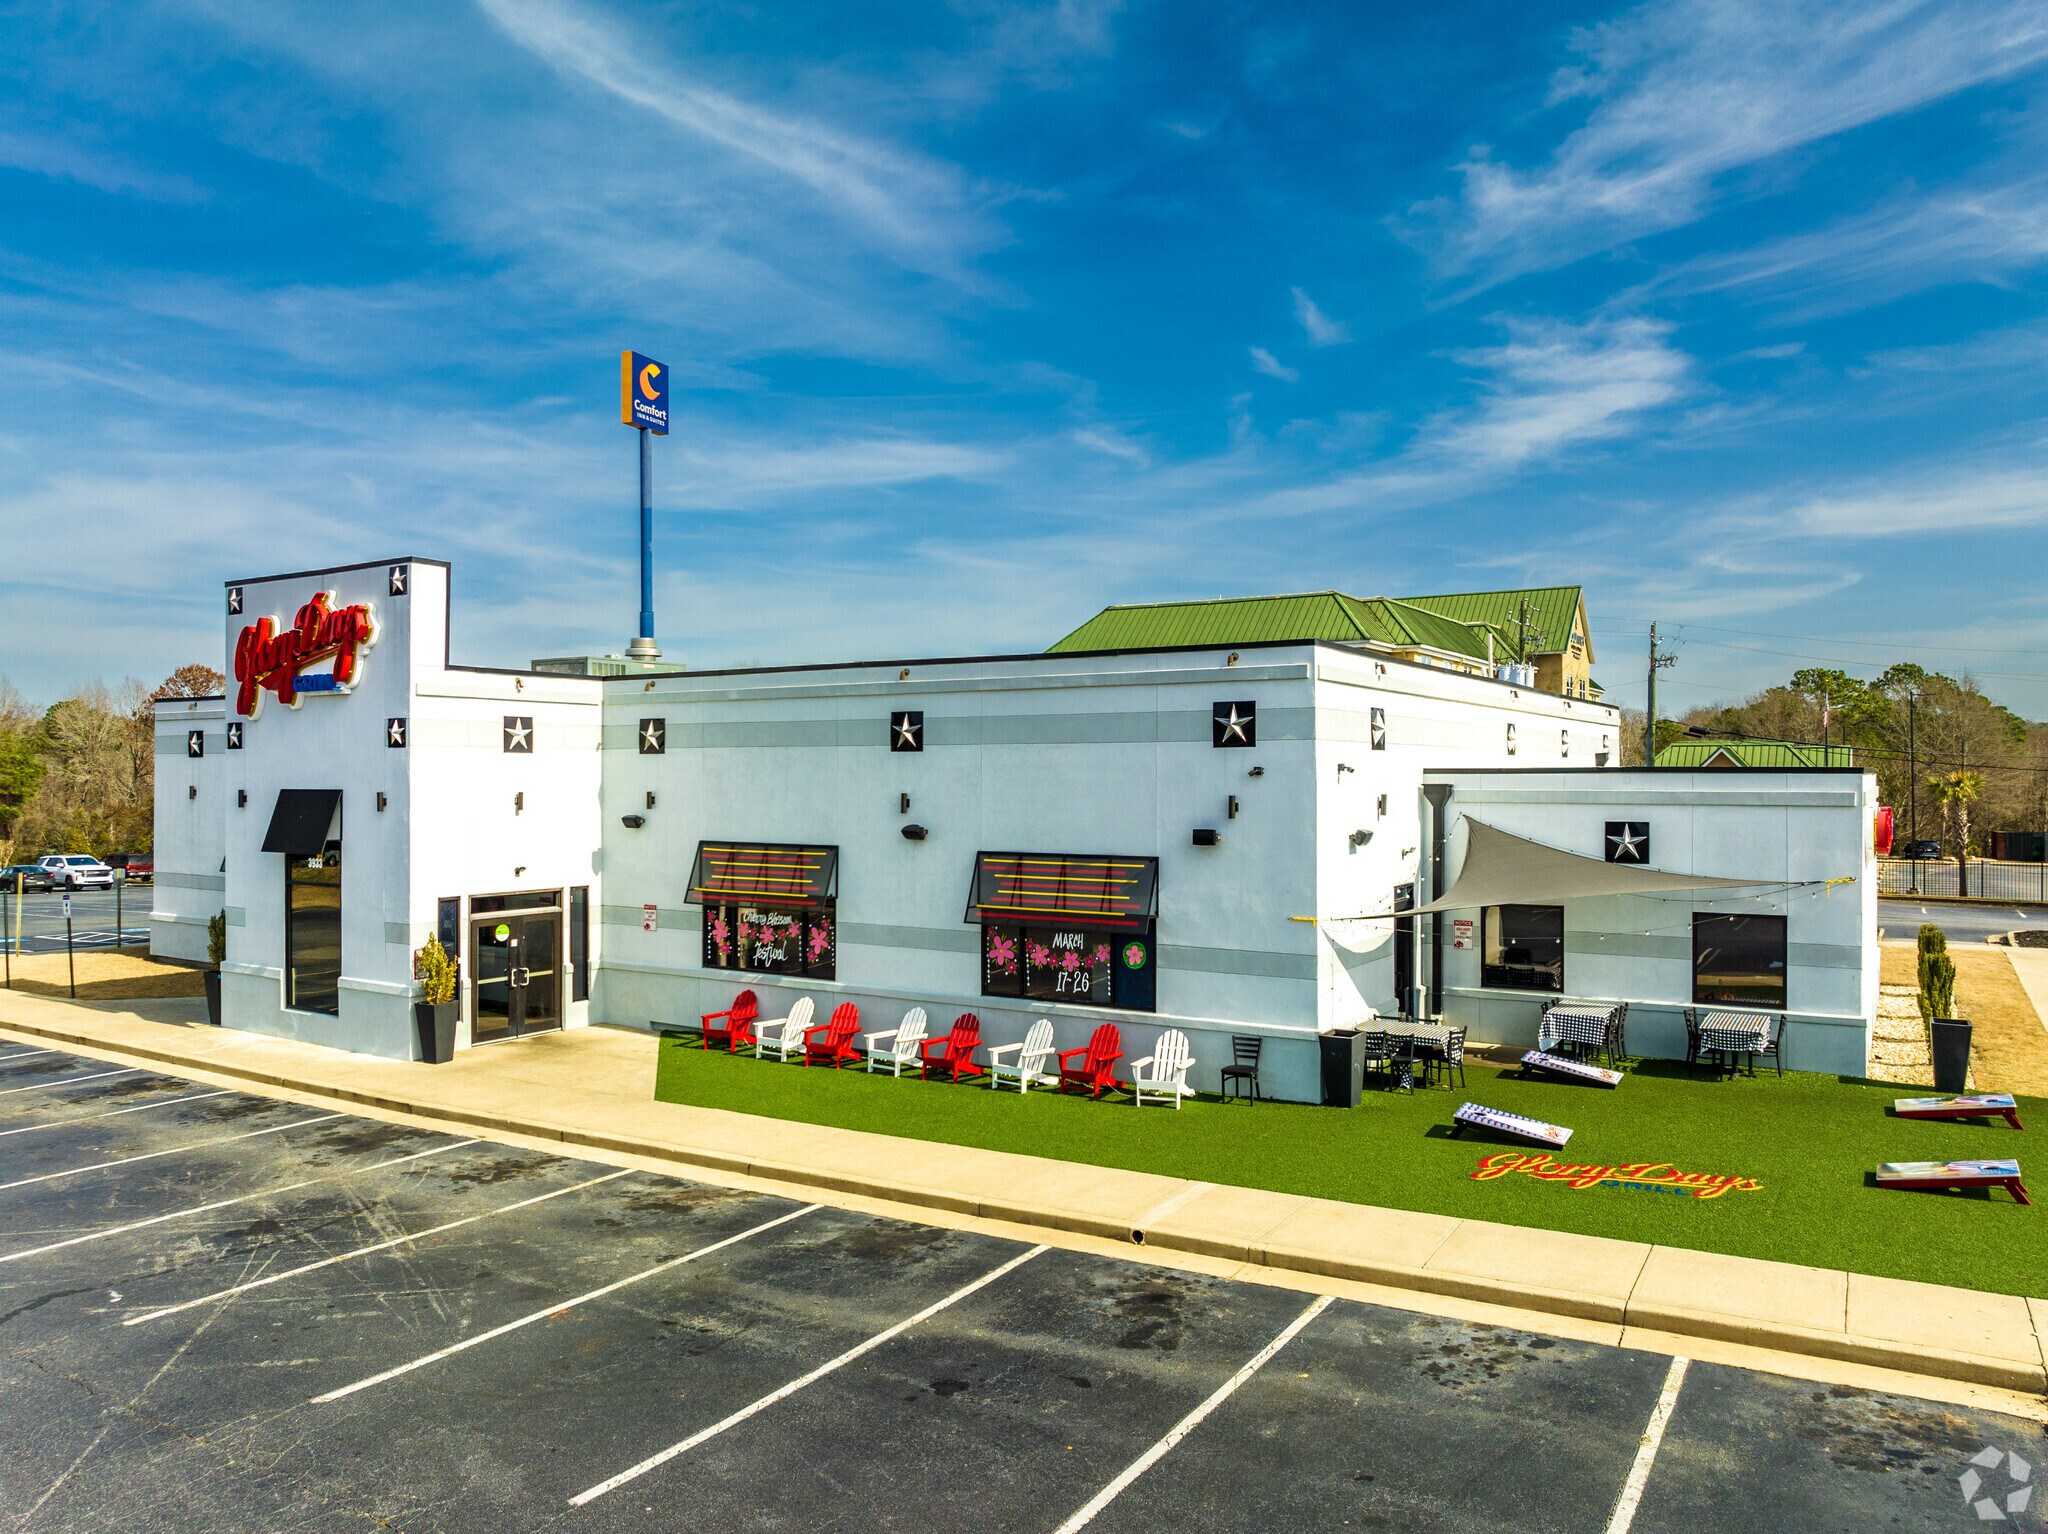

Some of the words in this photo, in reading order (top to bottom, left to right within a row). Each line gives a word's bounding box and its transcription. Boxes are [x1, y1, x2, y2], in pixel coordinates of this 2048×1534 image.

[634, 399, 667, 420] Comfort
[650, 416, 665, 427] SUITES
[234, 616, 302, 716] Glory
[294, 591, 373, 684] Days
[1052, 932, 1084, 950] MARCH
[752, 940, 789, 968] Festival
[1471, 1152, 1616, 1189] Glory
[1618, 1162, 1764, 1199] Days
[1599, 1179, 1690, 1197] GRILL
